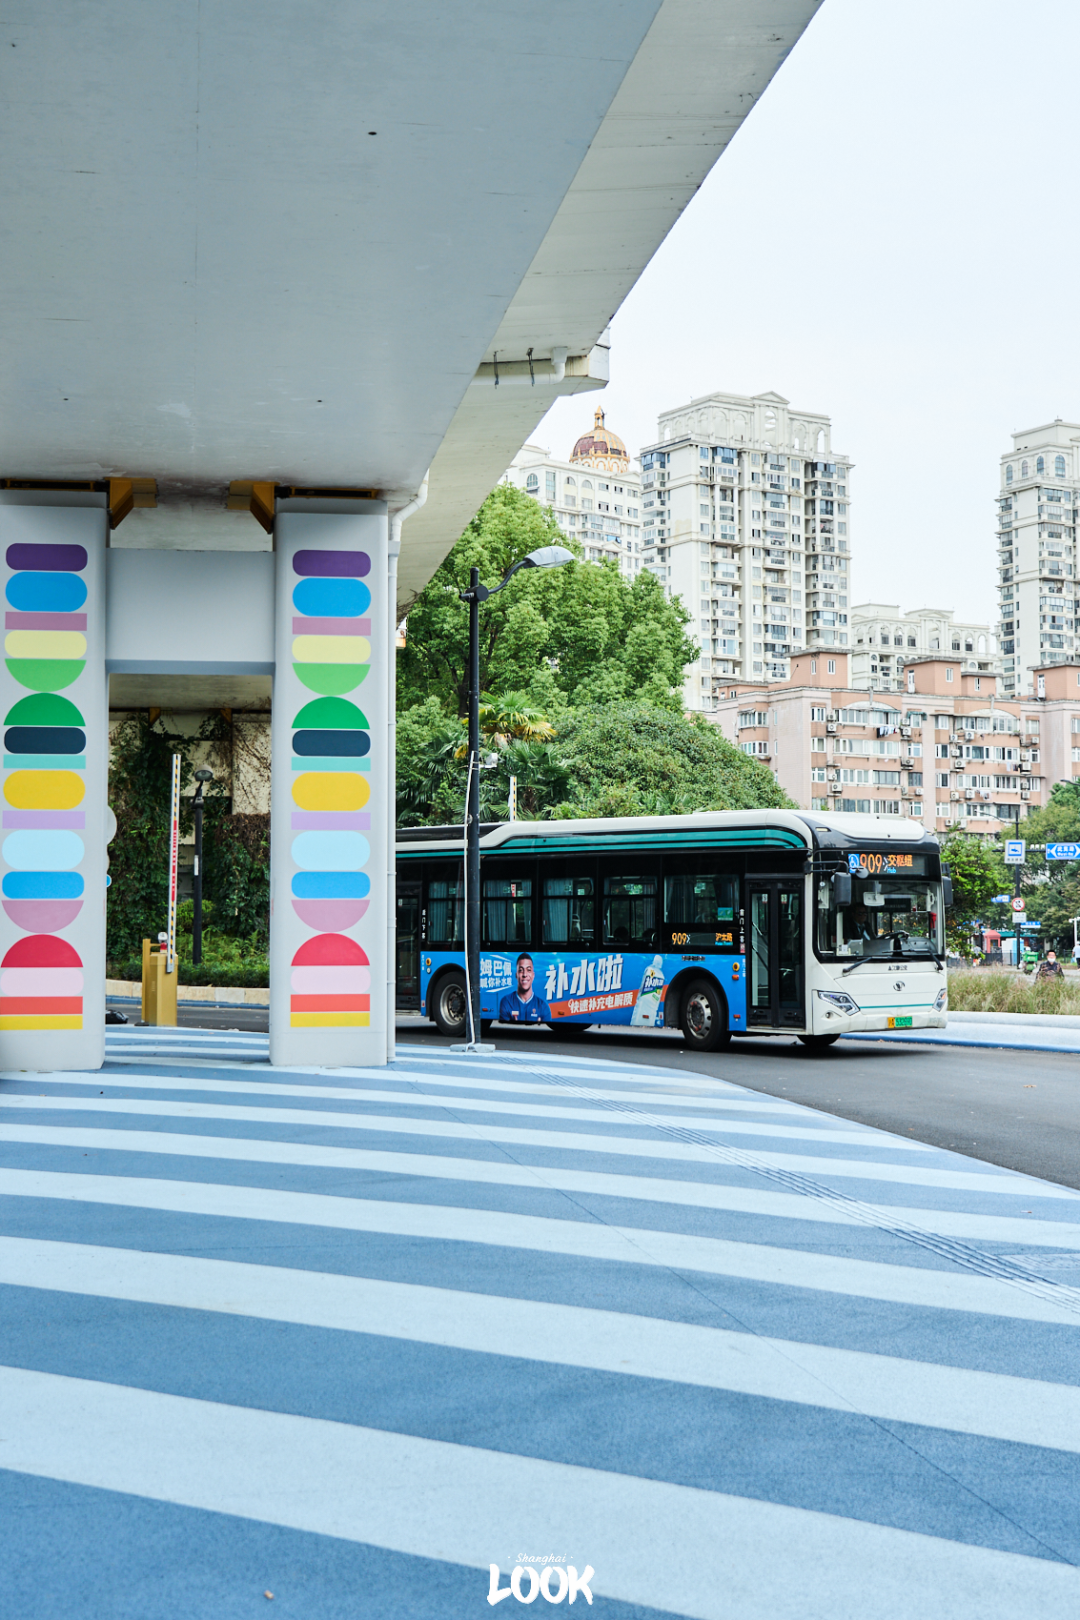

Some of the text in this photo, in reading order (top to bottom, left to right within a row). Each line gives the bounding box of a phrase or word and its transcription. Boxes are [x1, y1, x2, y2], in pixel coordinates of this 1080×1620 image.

[860, 854, 882, 873] 909
[672, 932, 687, 945] 909
[480, 958, 512, 976] 姆巴佩
[545, 954, 623, 1000] 补水啦
[570, 992, 633, 1013] 快速补充电解质
